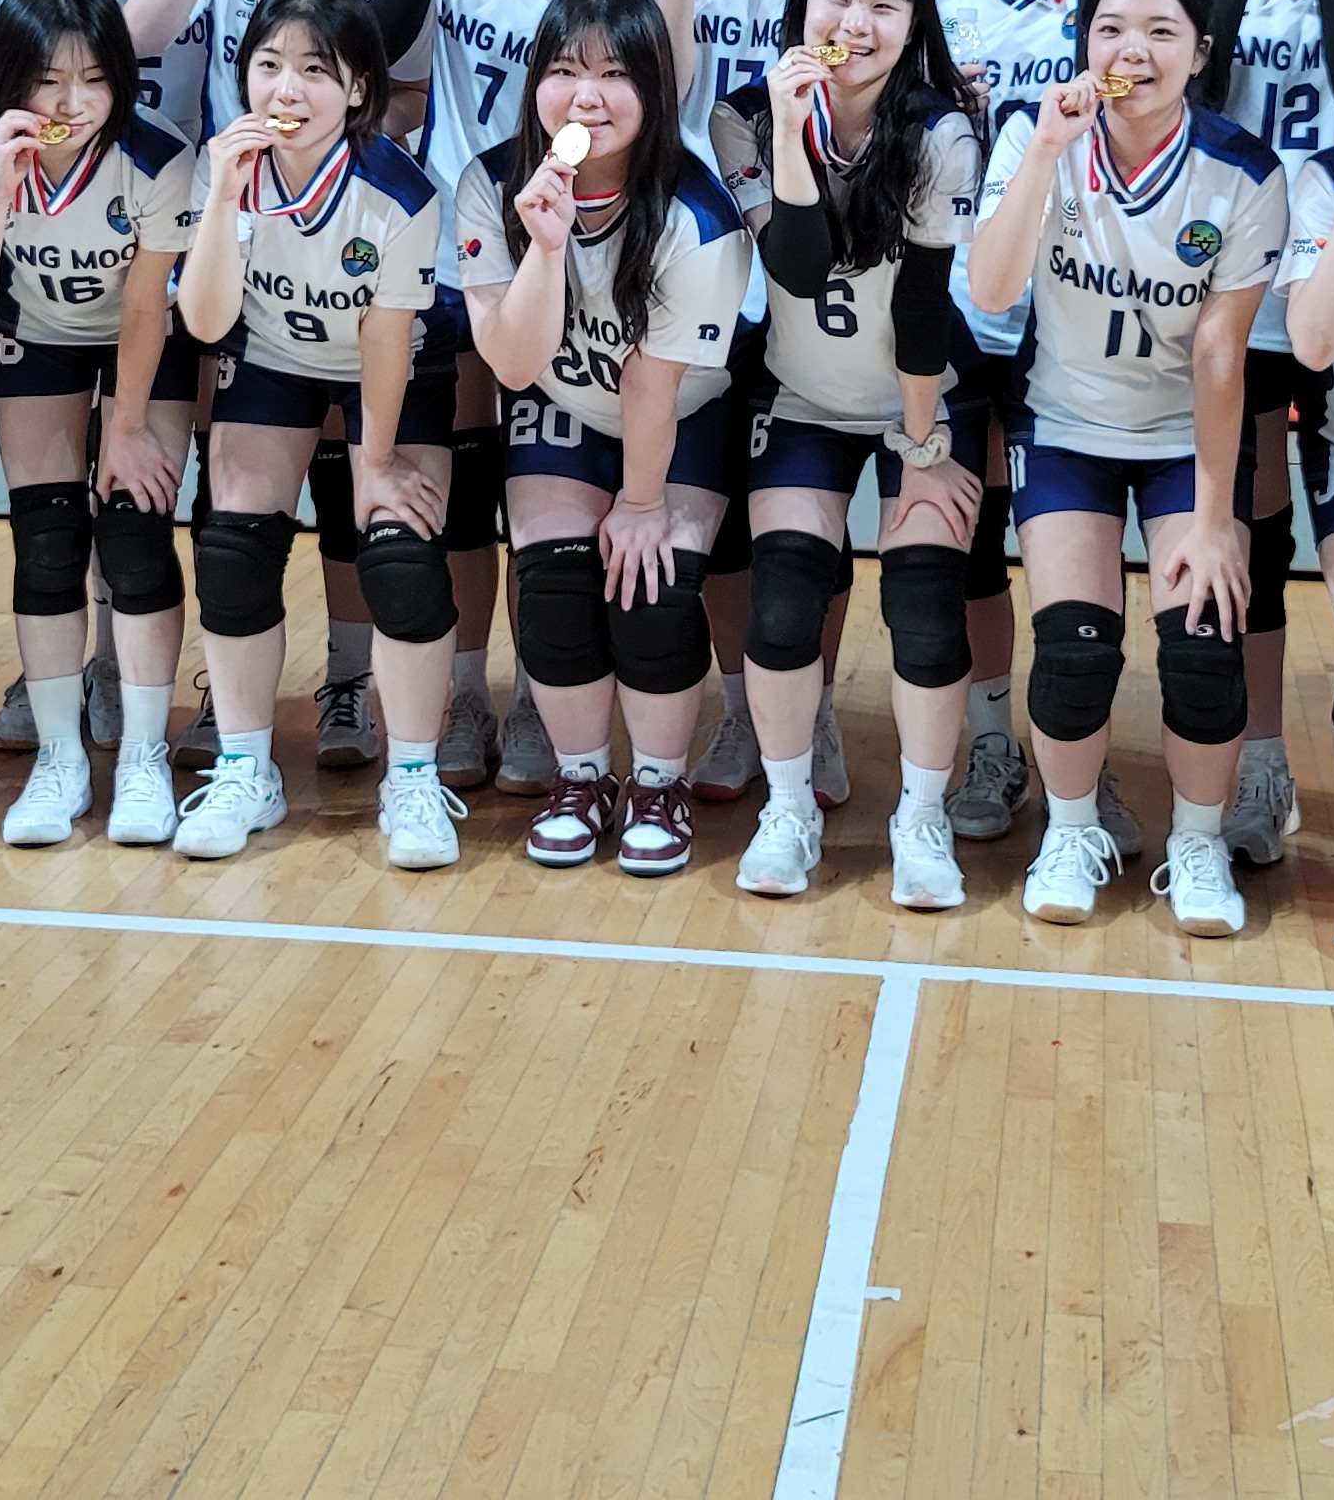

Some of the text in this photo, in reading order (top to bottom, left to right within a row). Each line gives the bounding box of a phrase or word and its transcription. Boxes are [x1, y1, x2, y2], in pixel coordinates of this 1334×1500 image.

[1009, 56, 1074, 87] MOO
[1232, 35, 1292, 71] ANG
[474, 62, 507, 125] 7
[1261, 82, 1320, 150] 12
[71, 243, 138, 270] MOO
[1049, 245, 1123, 298] SANG
[38, 273, 106, 304] 16
[305, 282, 373, 311] MOO
[284, 310, 330, 342] 9
[579, 308, 635, 346] MOO
[814, 279, 859, 338] 6
[1104, 309, 1153, 359] 11
[509, 399, 583, 448] 20
